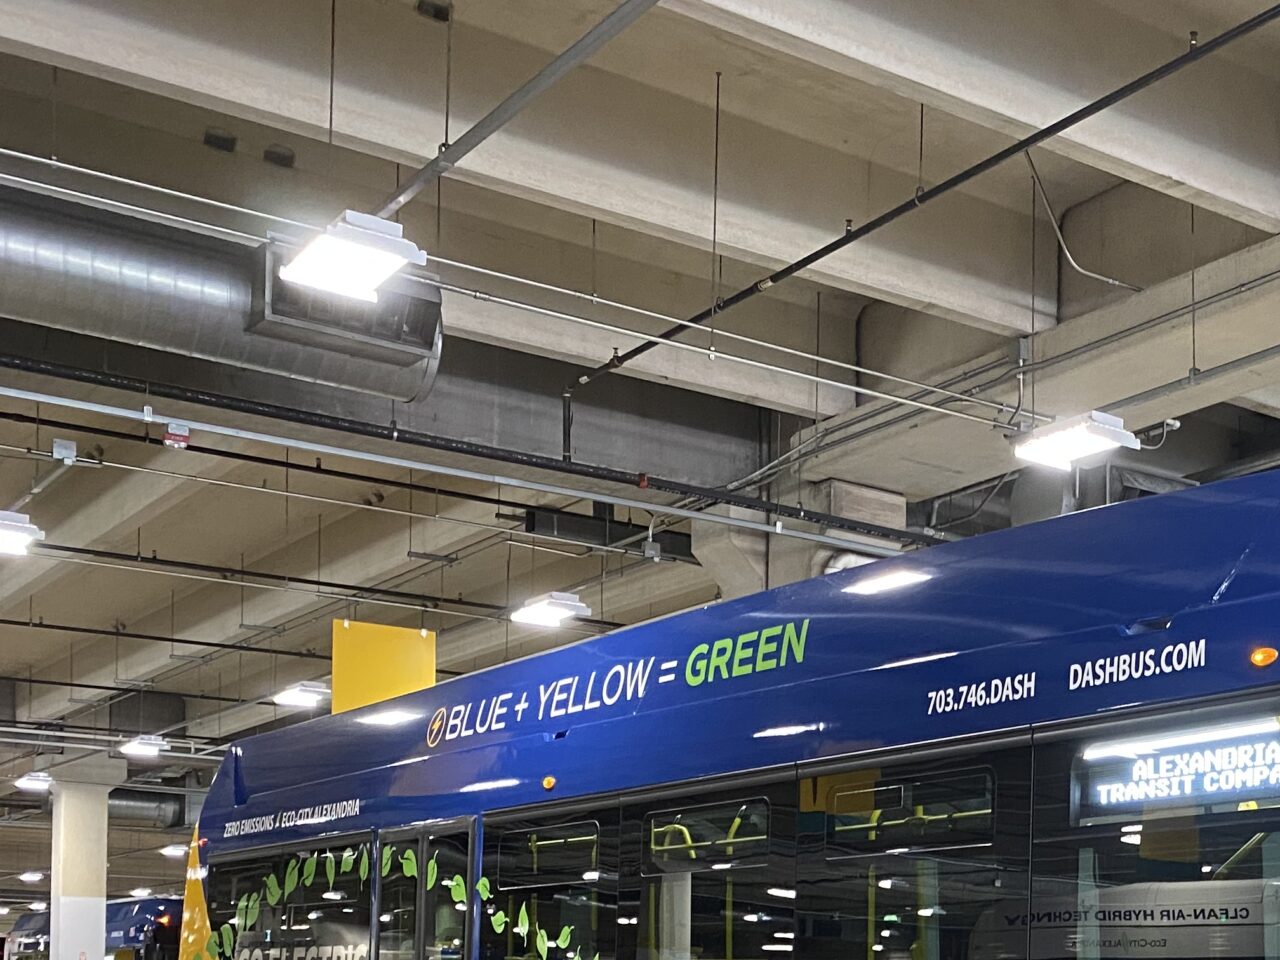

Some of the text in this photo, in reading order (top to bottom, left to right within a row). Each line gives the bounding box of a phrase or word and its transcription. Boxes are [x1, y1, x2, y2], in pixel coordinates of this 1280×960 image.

[445, 618, 810, 741] BLUE + YELLOW = GREEN
[1068, 638, 1206, 690] DASHBUS.COM
[927, 671, 1036, 715] 703.746.DASH
[1096, 775, 1195, 804] TRANSIT
[223, 822, 240, 838] ZERO
[240, 814, 274, 835] EMISSIONS
[313, 799, 360, 819] ALEXANDRIA
